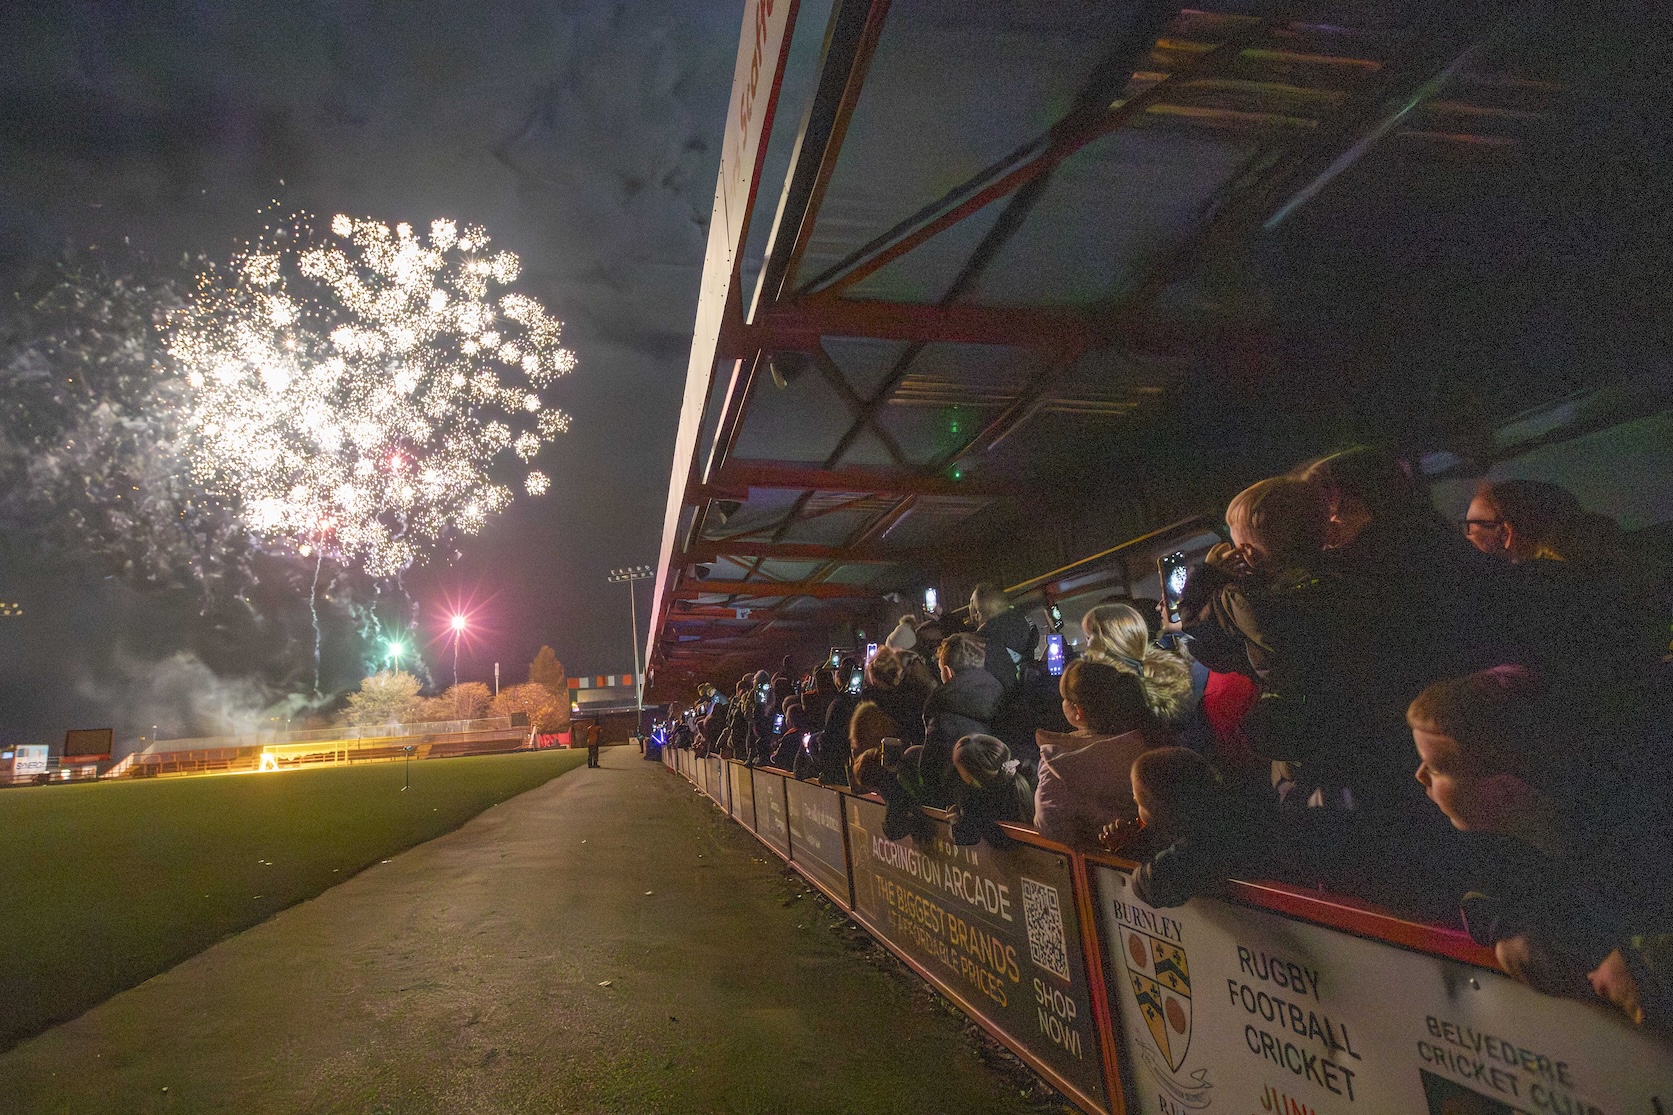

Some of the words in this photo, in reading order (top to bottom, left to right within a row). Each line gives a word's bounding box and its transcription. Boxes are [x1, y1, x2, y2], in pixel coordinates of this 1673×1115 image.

[933, 837, 959, 858] HOP
[872, 835, 941, 893] ACCRINGTON
[944, 863, 1013, 922] ARCADE
[875, 874, 896, 907] THE
[898, 885, 944, 936] BIGGEST
[948, 913, 1020, 983] BRANDS
[1113, 900, 1183, 943] BURNLEY
[960, 955, 1008, 1008] PRICES
[1033, 977, 1077, 1022] SHOP
[1237, 945, 1320, 1001] RUGBY
[1037, 1006, 1082, 1060] NOW!
[1227, 978, 1362, 1061] FOOTBALL
[1245, 1024, 1356, 1101] CRICKET
[1417, 1040, 1519, 1097] CRICKET
[1425, 1014, 1575, 1088] BELVEDERE
[1260, 1083, 1316, 1115] JUN
